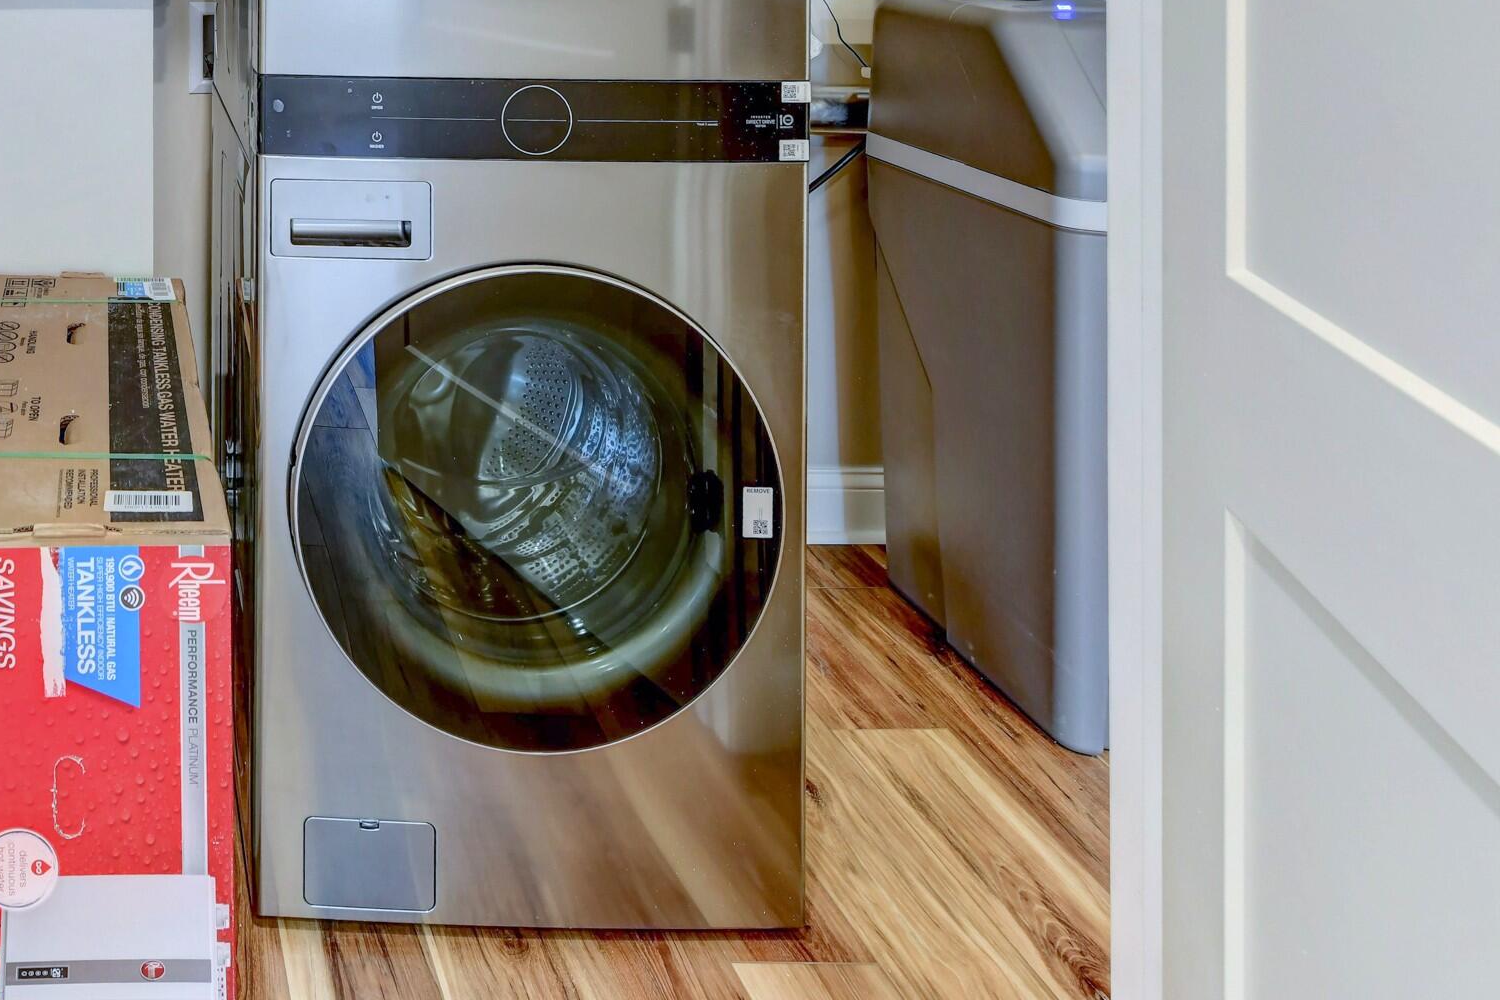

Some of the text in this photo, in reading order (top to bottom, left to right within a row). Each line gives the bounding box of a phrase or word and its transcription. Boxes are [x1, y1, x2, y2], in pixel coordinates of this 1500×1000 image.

[26, 330, 38, 355] HANDLING
[146, 302, 166, 346] CONDENSING
[152, 347, 171, 390] TANKLESS
[28, 396, 41, 422] TO OPEN
[157, 391, 174, 411] GAS
[158, 411, 179, 447] WATER
[67, 556, 75, 610] WATER HEATER
[168, 562, 226, 621] Rheem
[76, 557, 96, 674] TANKLESS
[96, 556, 105, 680] SUPER HIGH EFFICIENCY INDOOR
[104, 556, 116, 681] 199,900 BTU NATURAL GAS
[187, 629, 199, 724] PERFORMANCE
[8, 842, 17, 897] continuous
[19, 850, 28, 888] delivers
